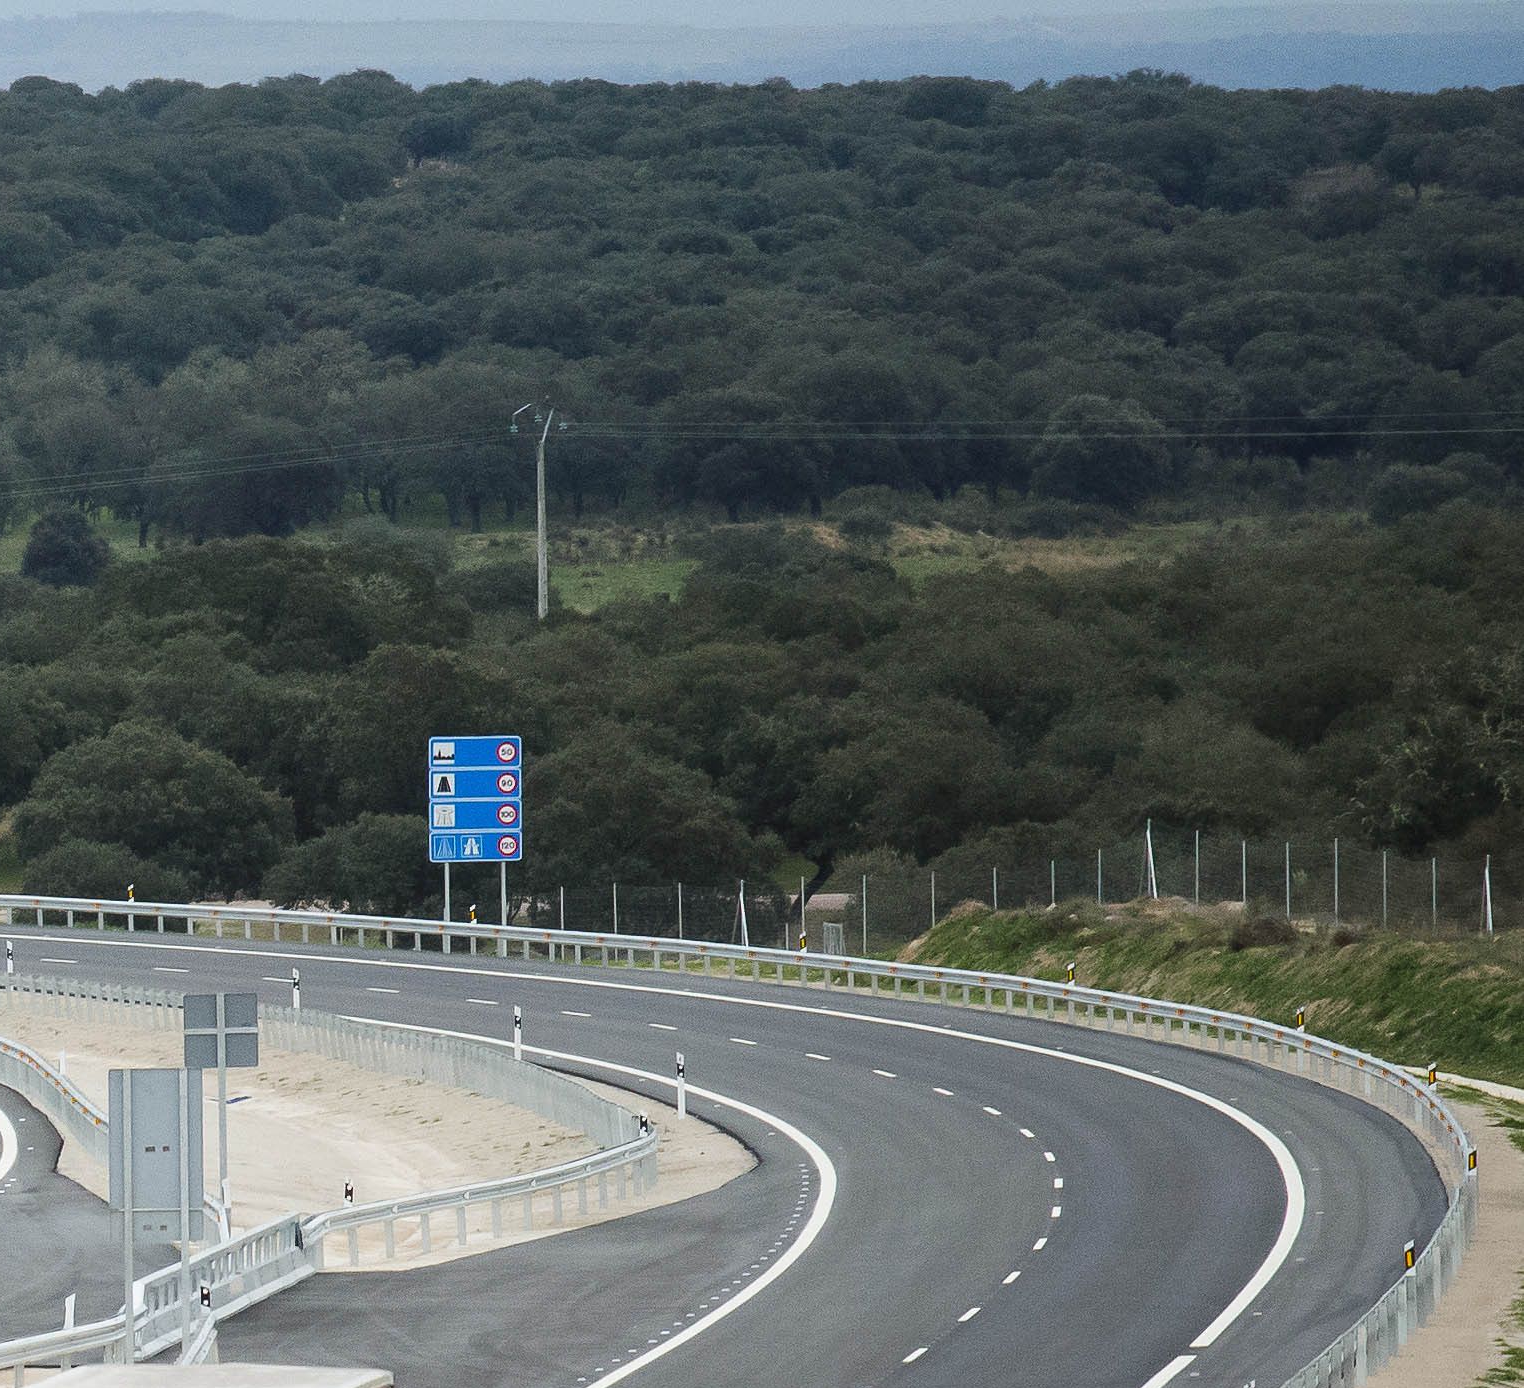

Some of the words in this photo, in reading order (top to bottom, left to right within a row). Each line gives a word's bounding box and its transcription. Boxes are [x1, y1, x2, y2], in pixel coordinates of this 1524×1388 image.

[501, 747, 513, 756] 50
[501, 778, 513, 787] 90
[501, 810, 514, 819] 100
[501, 841, 515, 850] 120
